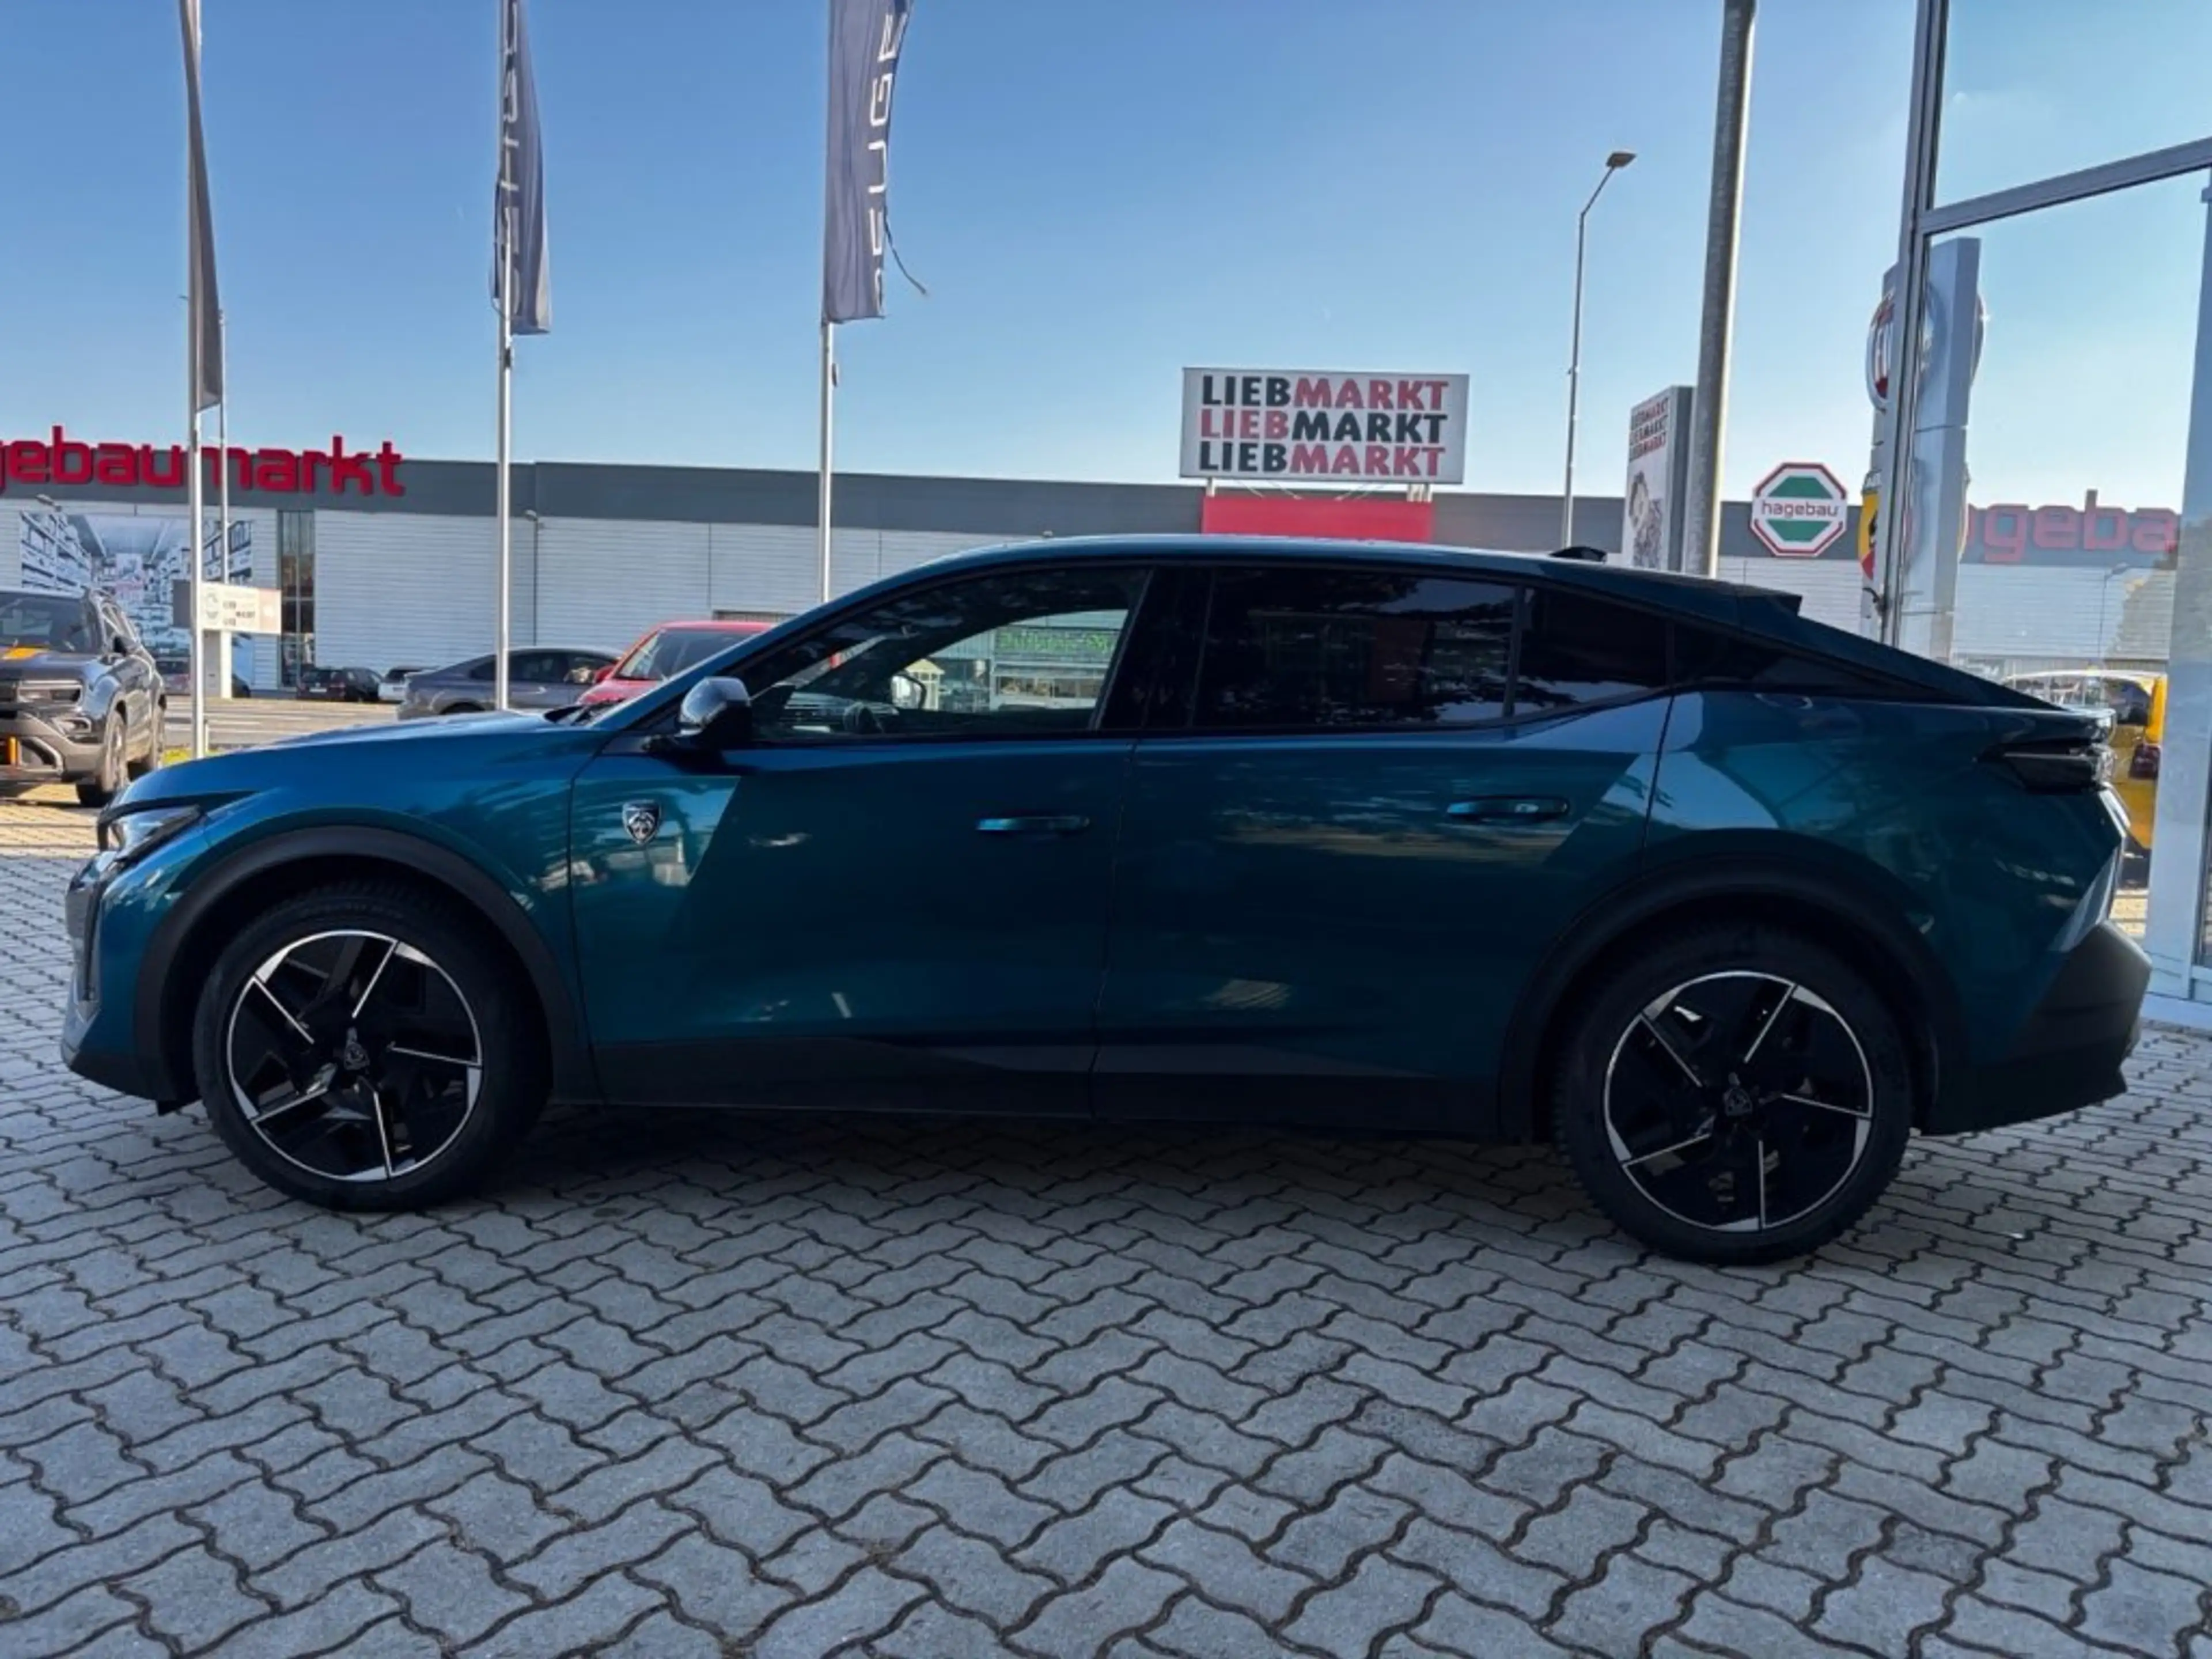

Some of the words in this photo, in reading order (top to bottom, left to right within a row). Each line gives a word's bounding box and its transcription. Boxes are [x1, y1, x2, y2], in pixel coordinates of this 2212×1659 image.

[1203, 376, 1449, 410] LIEBMARKT
[1201, 409, 1448, 443] LIEBMARKT
[0, 425, 407, 497] ebaumarkt
[1199, 441, 1446, 476] LIEBMARKT
[1762, 499, 1839, 518] hagebau
[1967, 489, 2179, 562] geba
